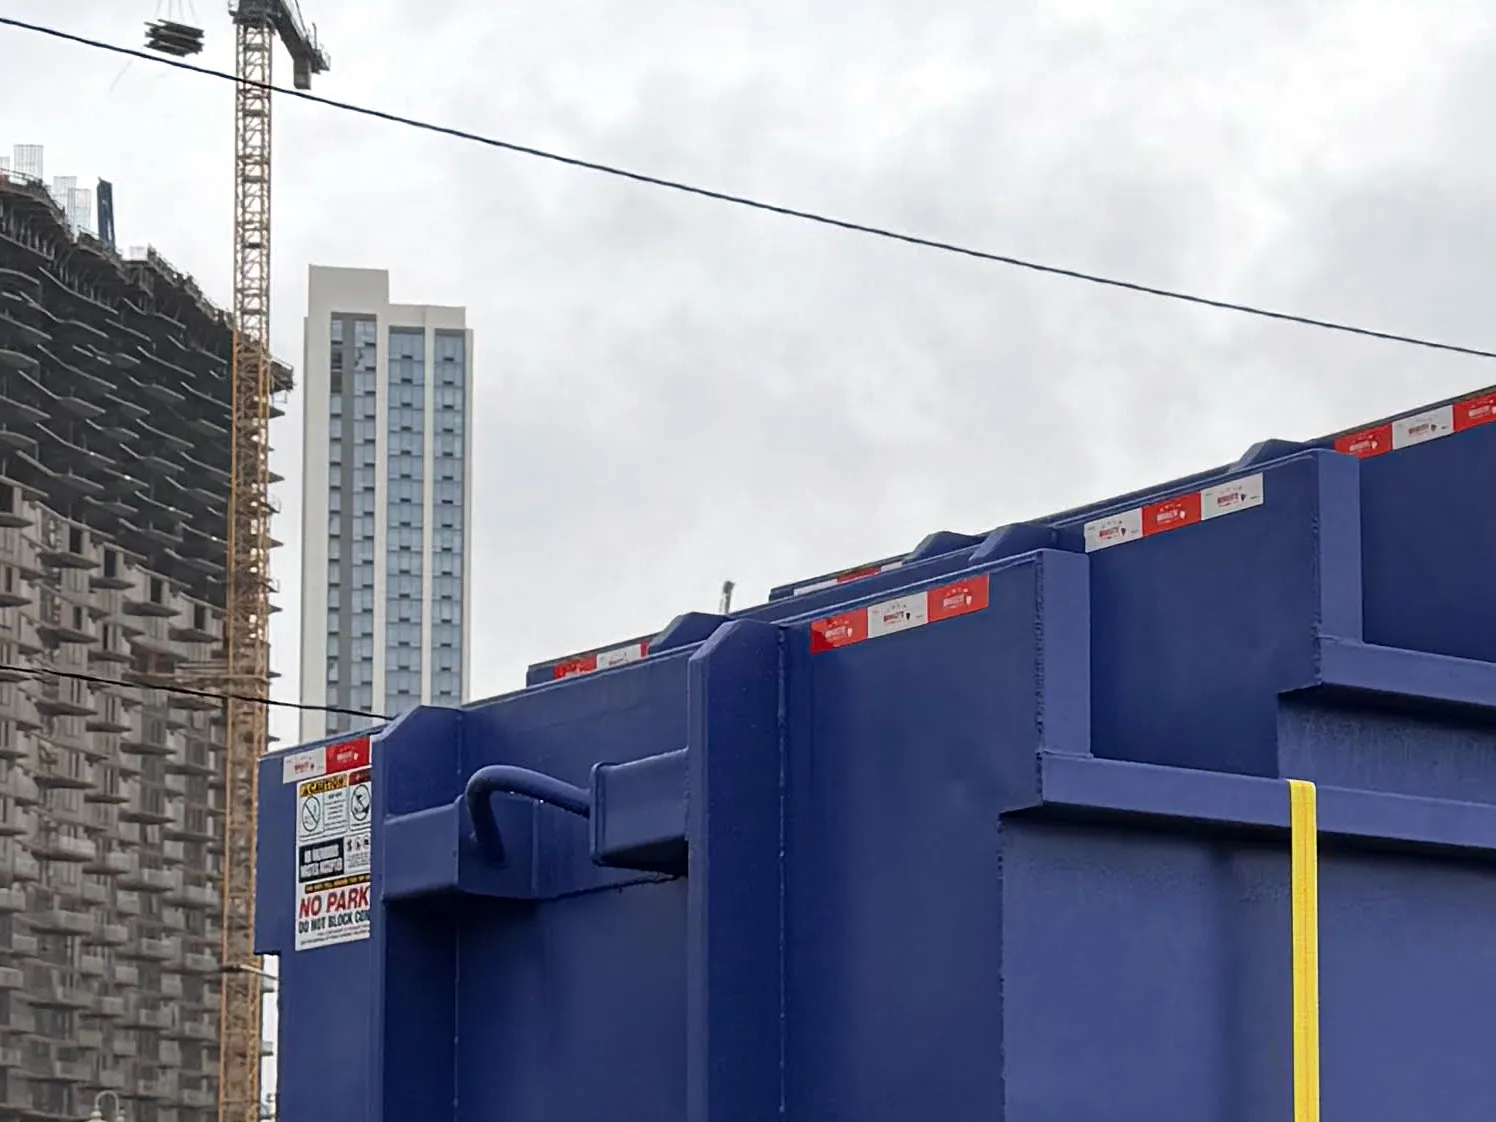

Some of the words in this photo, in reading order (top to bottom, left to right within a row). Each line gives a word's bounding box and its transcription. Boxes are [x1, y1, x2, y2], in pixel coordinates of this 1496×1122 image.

[299, 895, 322, 918] NO
[326, 886, 371, 913] PARK
[298, 920, 310, 933] DO
[311, 916, 326, 931] NOT
[328, 910, 354, 928] BLOCK
